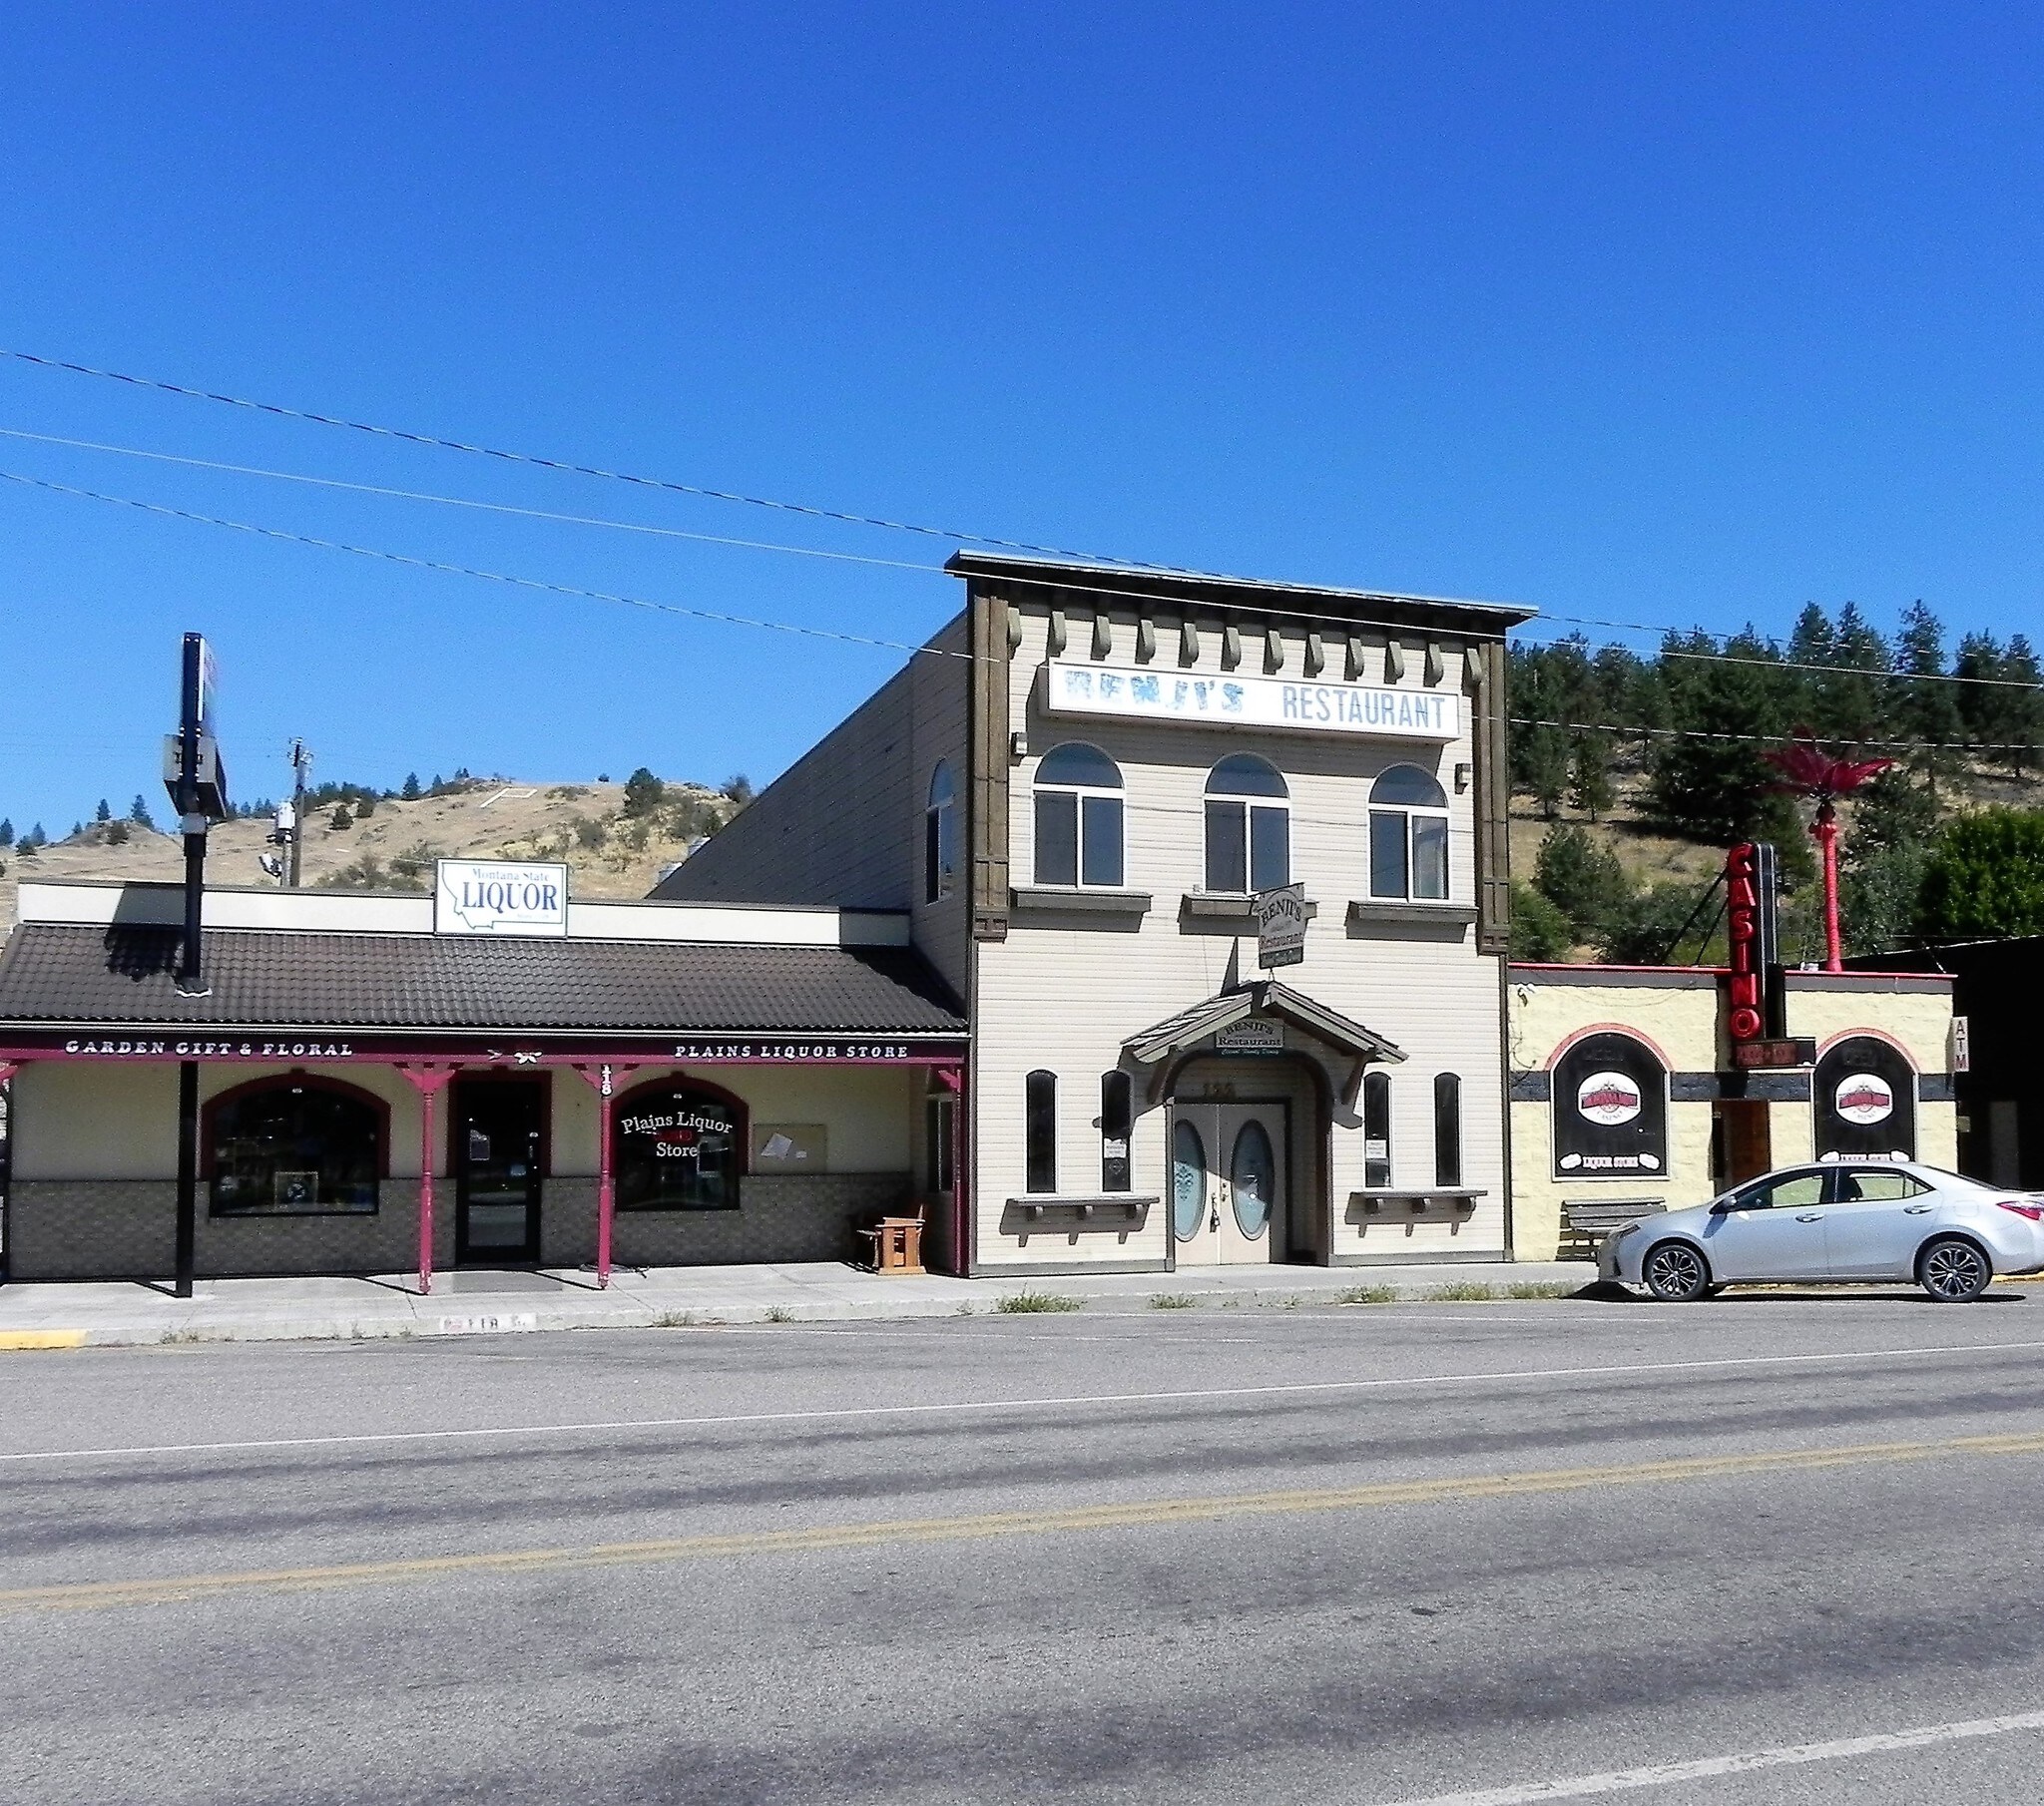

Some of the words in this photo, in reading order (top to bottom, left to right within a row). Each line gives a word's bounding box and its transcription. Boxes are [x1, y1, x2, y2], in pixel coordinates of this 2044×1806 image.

[1282, 685, 1445, 729] RESTAURANT
[472, 868, 519, 881] Montana
[462, 881, 558, 914] LIQUOR
[1728, 842, 1761, 1040] CASINO
[65, 1041, 166, 1055] GARDEN
[175, 1042, 232, 1056] GIFT
[239, 1043, 252, 1056] &
[261, 1044, 353, 1057] FLORAL
[674, 1045, 751, 1058] PLAINS
[760, 1046, 838, 1060] LIQUOR
[845, 1046, 908, 1059] STORE
[1955, 1020, 1967, 1072] ATM
[601, 1064, 612, 1096] 118
[621, 1114, 673, 1134] Plains
[677, 1112, 733, 1133] Liquor
[656, 1141, 699, 1157] Store
